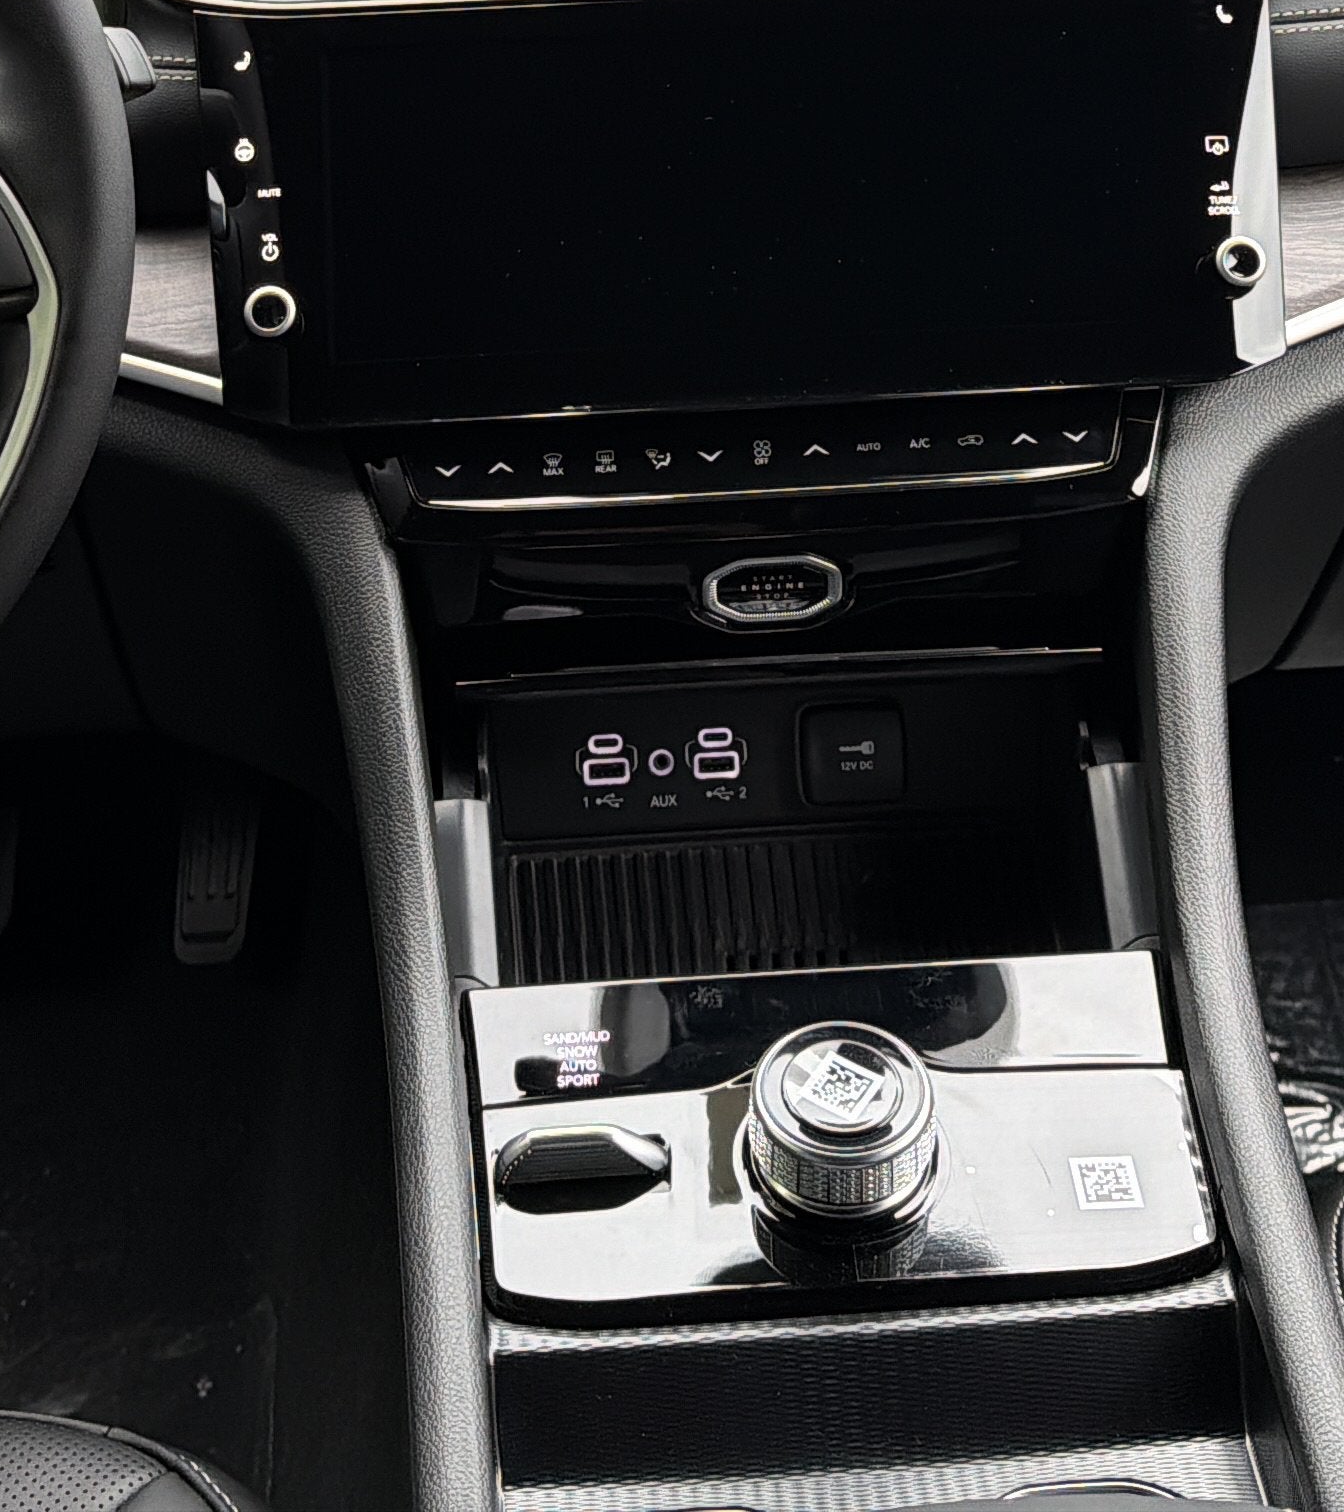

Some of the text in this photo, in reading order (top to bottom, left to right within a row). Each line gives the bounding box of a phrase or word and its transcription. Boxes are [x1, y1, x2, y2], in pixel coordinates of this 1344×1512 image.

[257, 188, 281, 198] MUTE
[856, 442, 881, 452] AUTO
[909, 438, 931, 449] A/C
[543, 468, 564, 476] MAX
[595, 464, 617, 473] REAR
[741, 582, 804, 591] ENGINE
[840, 760, 874, 770] 12V DC
[739, 787, 747, 799] 2
[582, 797, 588, 807] 1
[650, 794, 677, 808] AUX
[543, 1030, 610, 1045] SAND/MUD
[557, 1045, 598, 1059] SNOW
[560, 1059, 596, 1073] AUTO
[557, 1073, 600, 1089] SPORT
